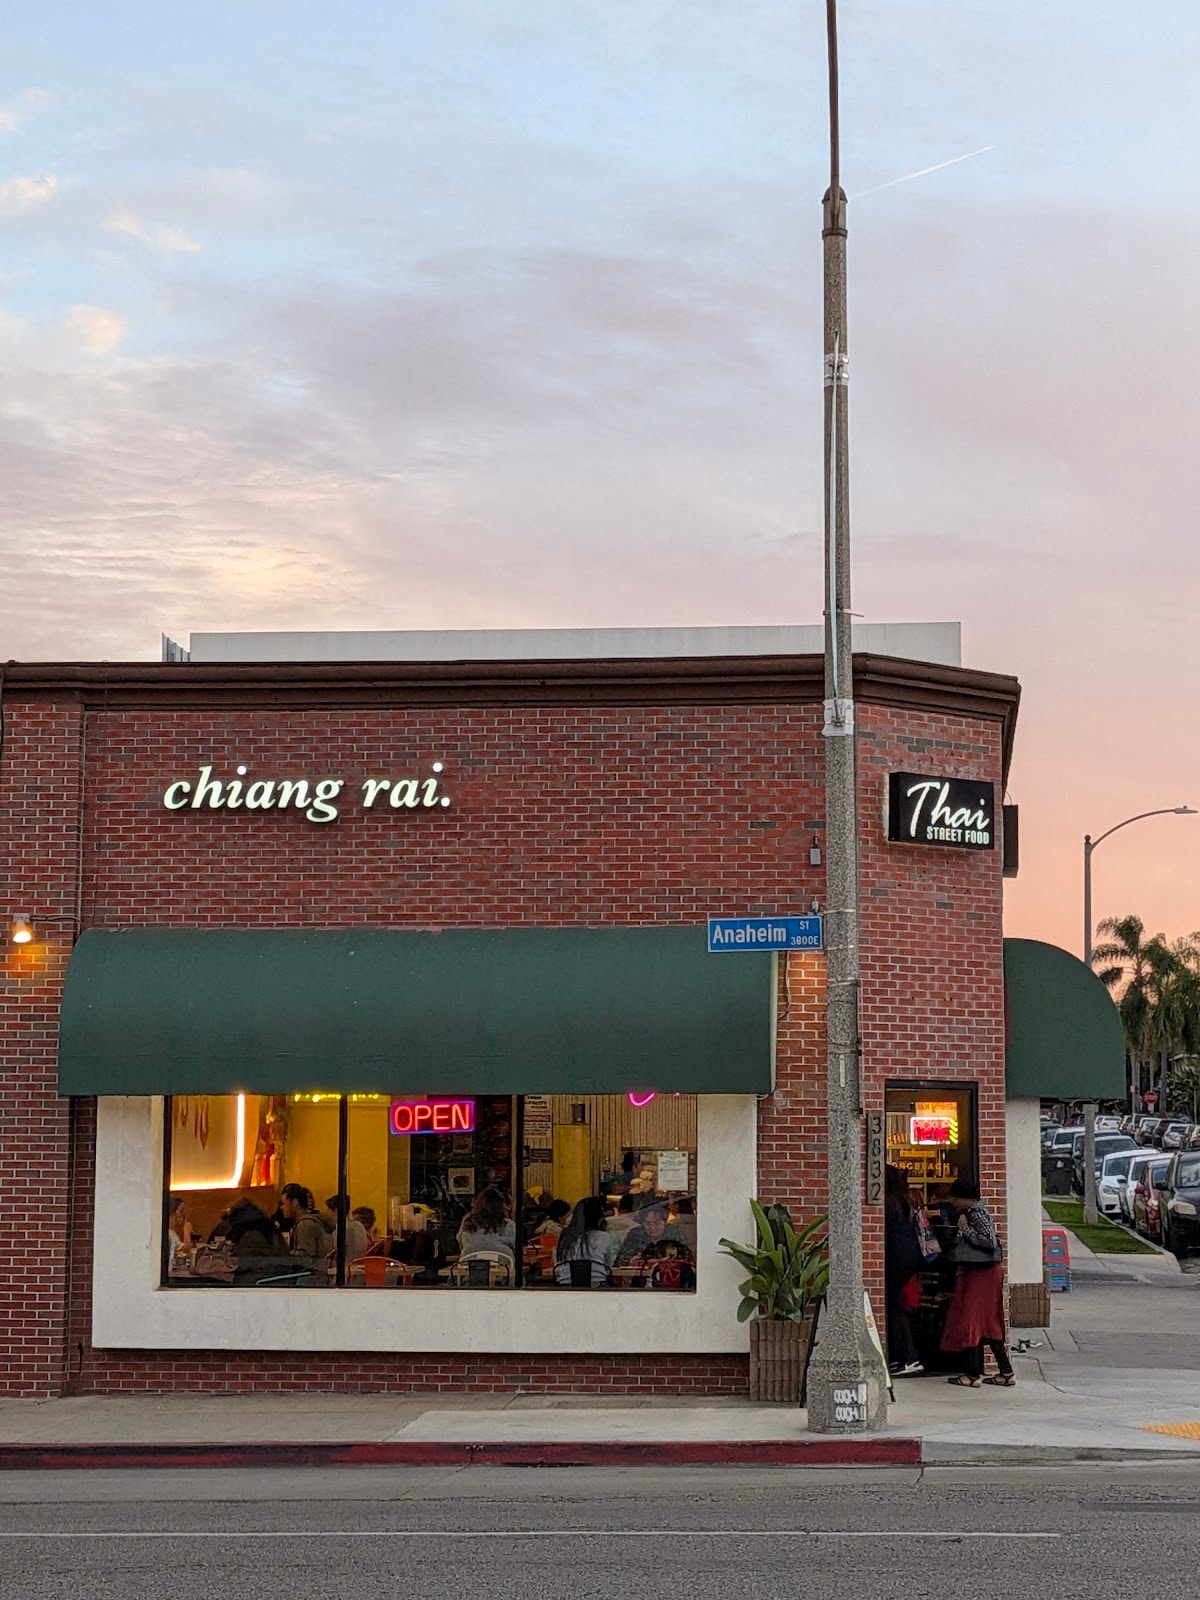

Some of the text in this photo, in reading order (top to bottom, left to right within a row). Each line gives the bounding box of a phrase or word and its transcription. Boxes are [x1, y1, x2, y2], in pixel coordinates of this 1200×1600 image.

[163, 762, 451, 823] chiang rai.
[906, 781, 990, 838] Thai
[926, 826, 990, 844] STREET FOOD
[712, 920, 810, 944] Anaheim ST
[790, 935, 819, 946] 3800E
[394, 1103, 470, 1131] OPEN
